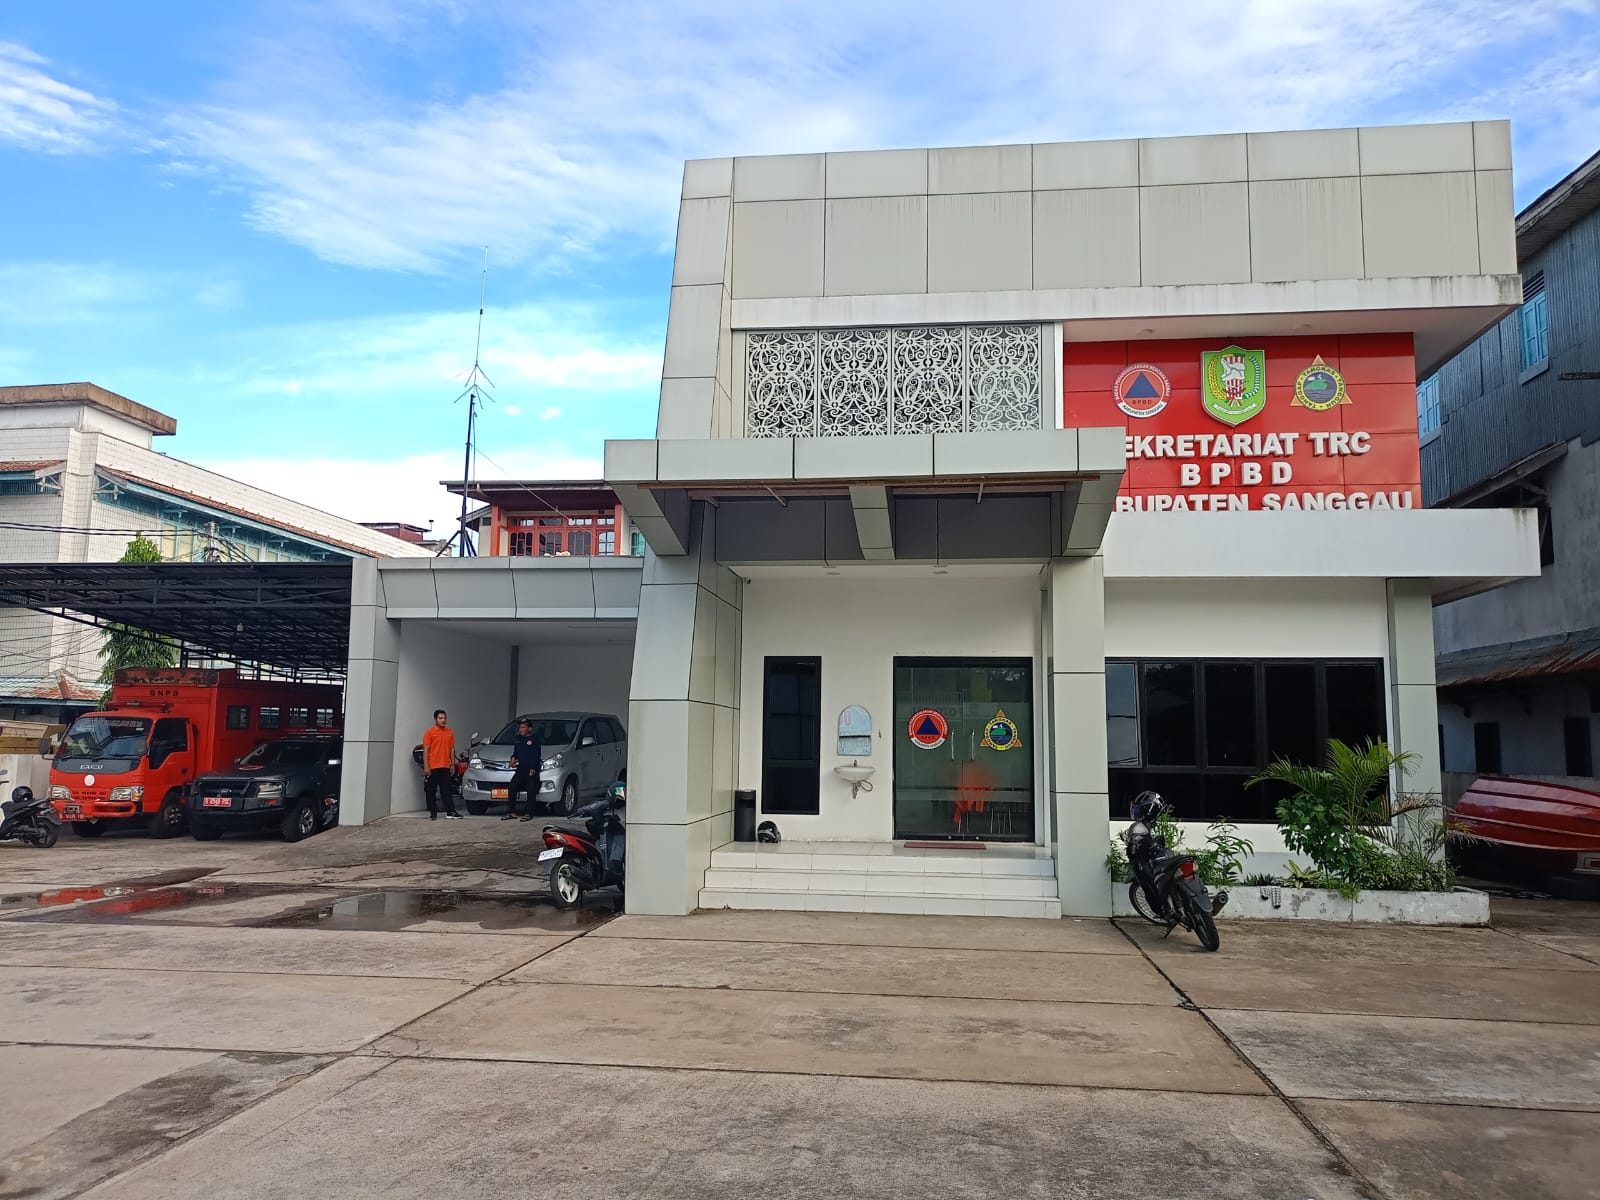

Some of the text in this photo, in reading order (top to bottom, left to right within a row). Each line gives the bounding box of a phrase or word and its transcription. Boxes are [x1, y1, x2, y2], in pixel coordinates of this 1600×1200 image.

[1126, 431, 1371, 458] EKRETARIAT TRC
[1116, 490, 1413, 512] BUPATEN SANGGAU
